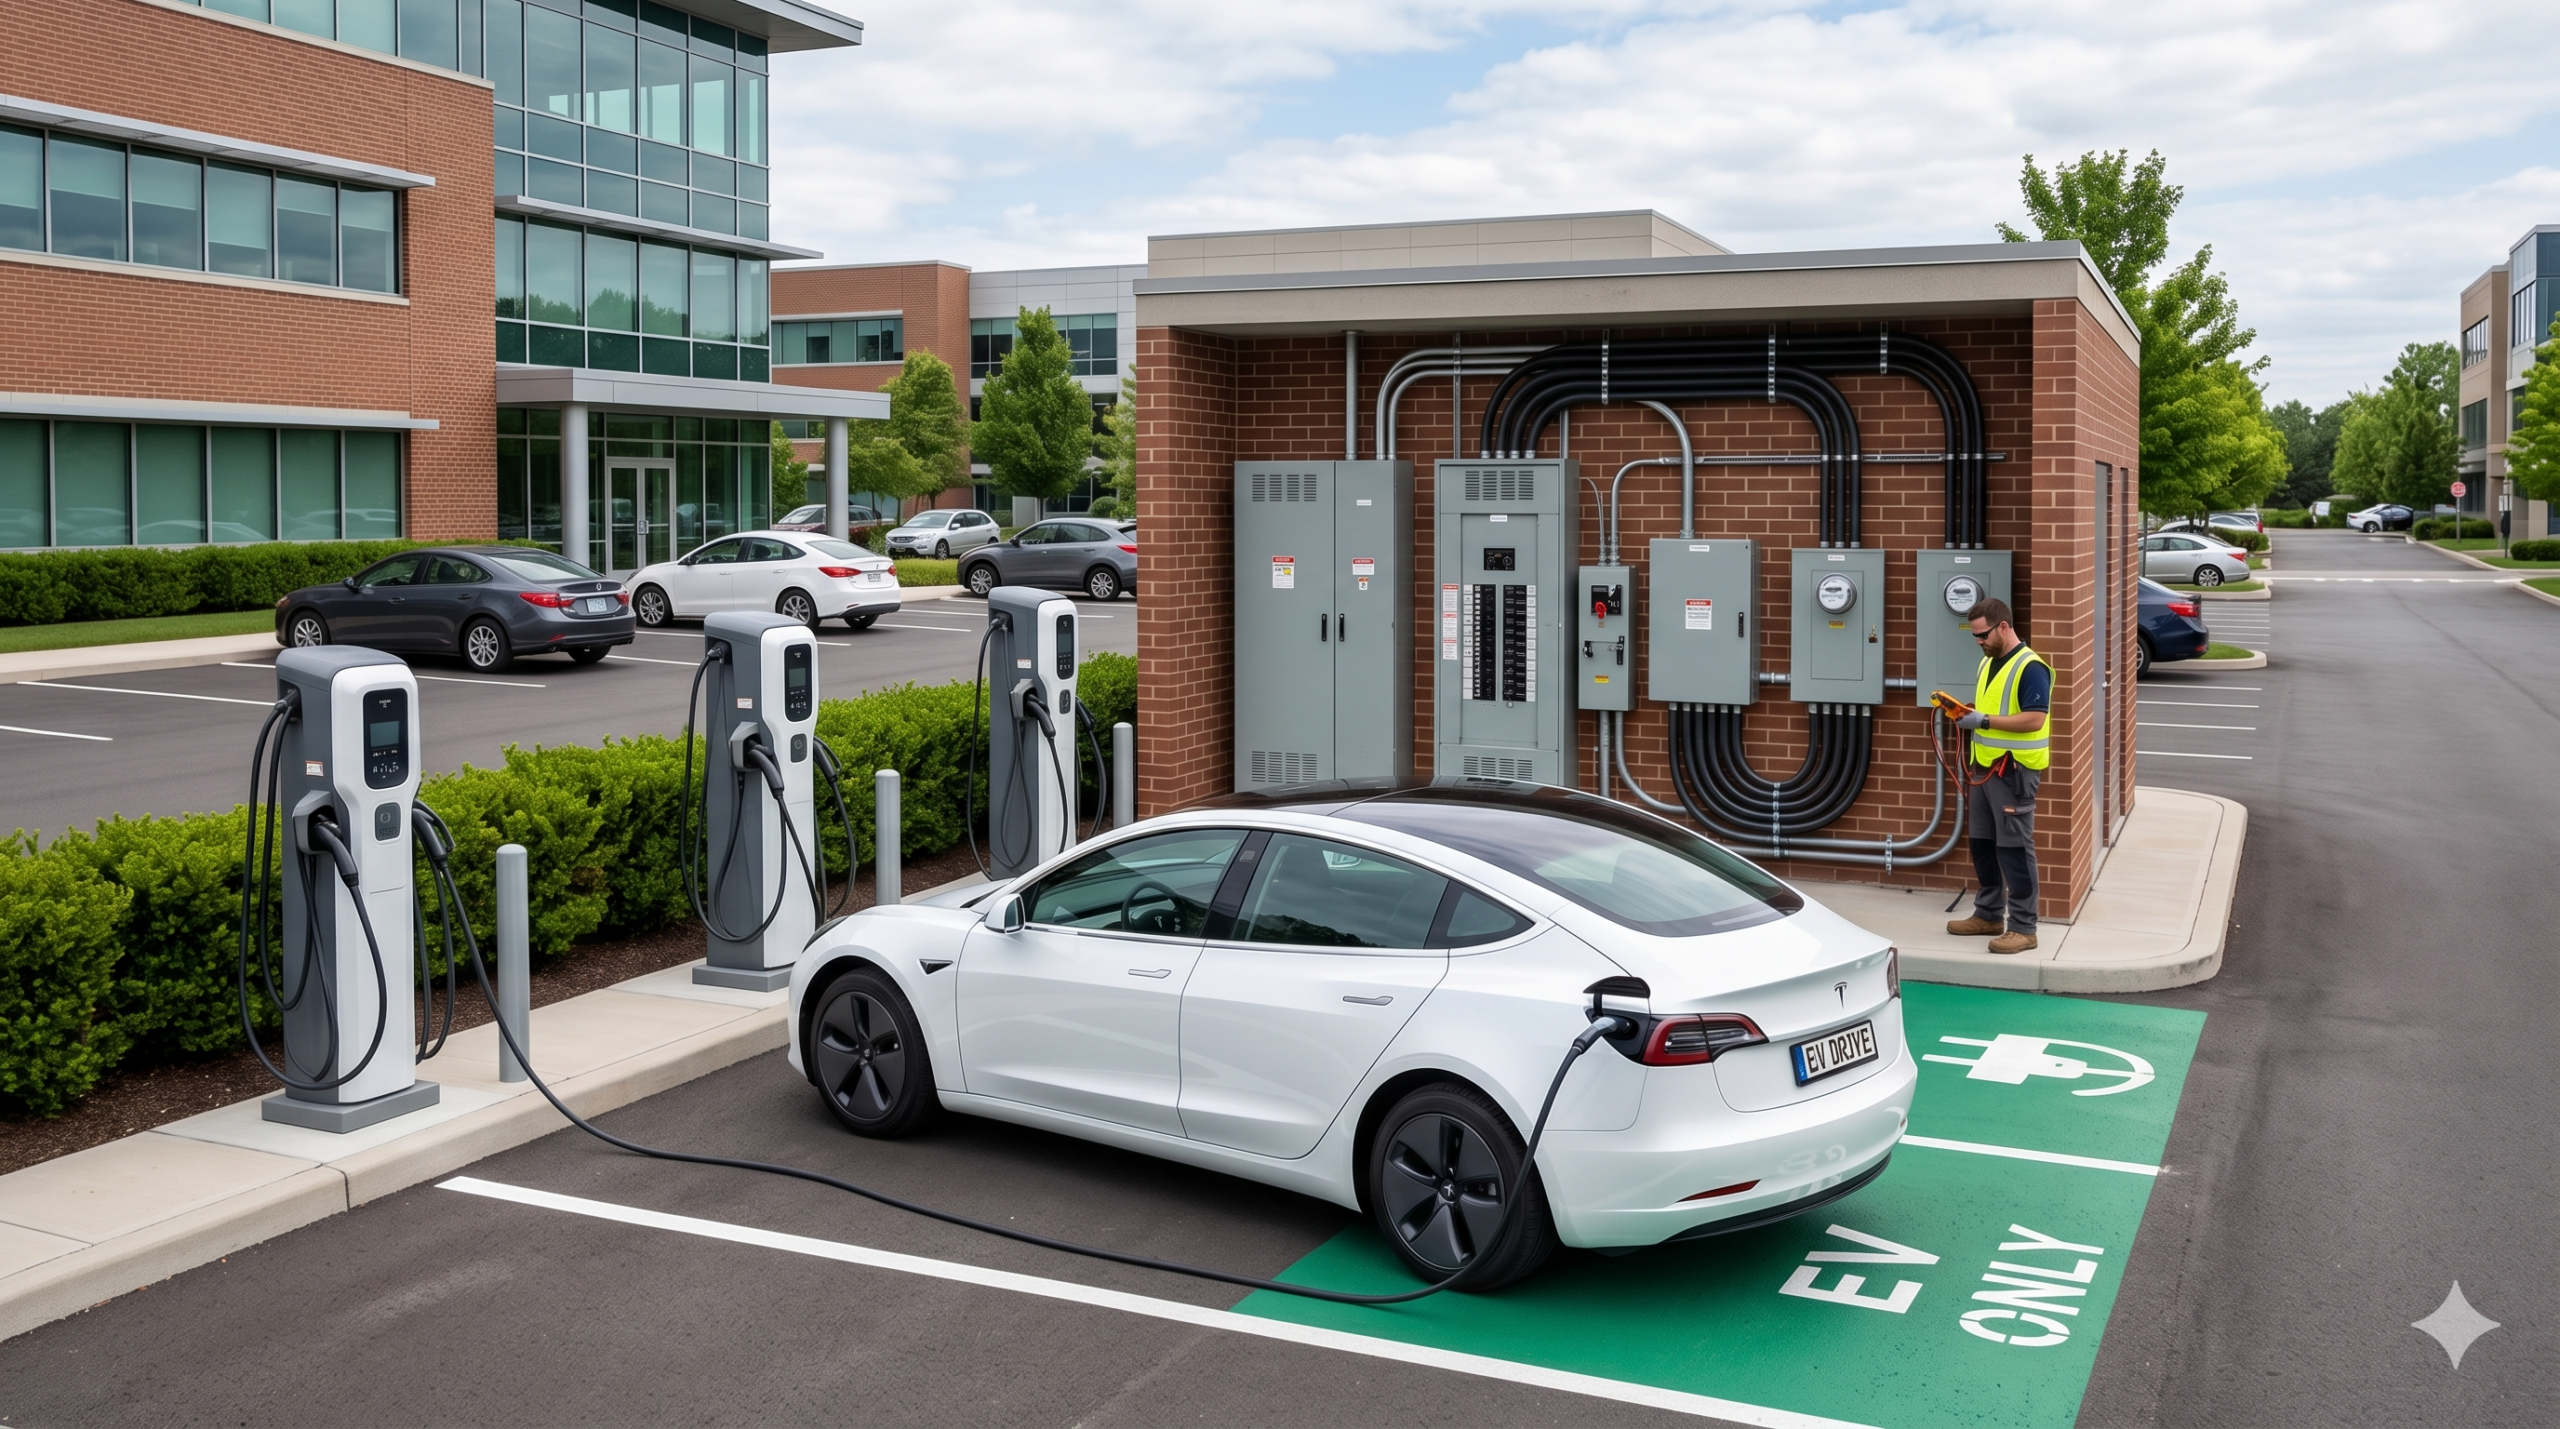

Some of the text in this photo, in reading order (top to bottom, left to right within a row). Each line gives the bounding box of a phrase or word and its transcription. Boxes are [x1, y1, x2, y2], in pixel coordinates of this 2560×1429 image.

[1806, 1042, 1826, 1073] EV
[1778, 1223, 1940, 1314] EV
[1959, 1223, 2105, 1347] ONLY
